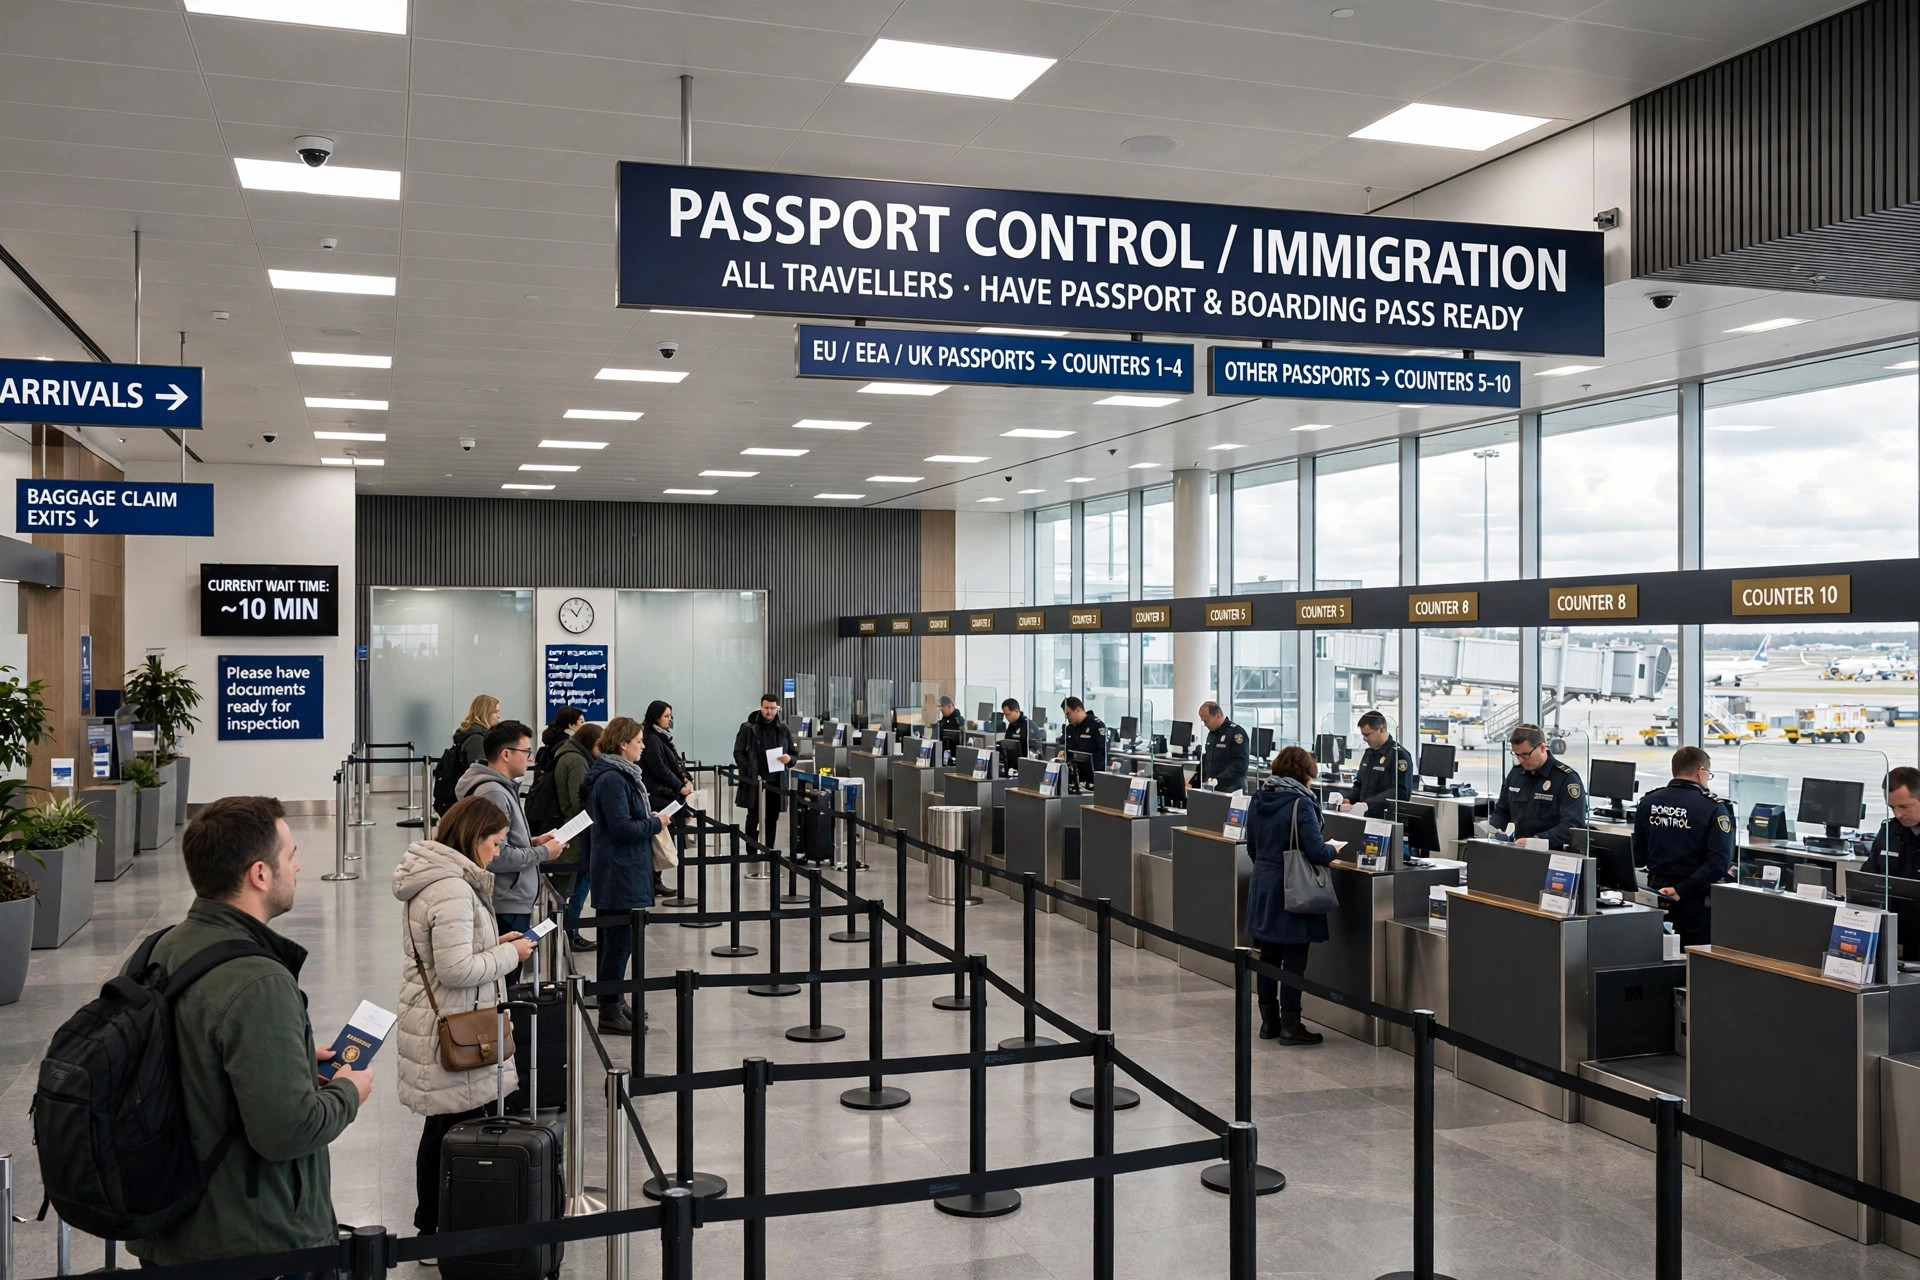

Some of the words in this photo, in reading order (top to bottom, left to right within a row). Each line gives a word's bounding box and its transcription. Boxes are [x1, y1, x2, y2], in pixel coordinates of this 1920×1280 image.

[669, 187, 951, 253] PASSPORT
[966, 208, 1205, 274] CONTROL
[1218, 224, 1237, 273] /
[1252, 227, 1567, 293] IMMIGRATION
[722, 260, 774, 289] ALL
[782, 263, 953, 299] TRAVELLERS
[981, 275, 1051, 305] HAVE
[1062, 280, 1196, 312] PASSPORT
[1204, 289, 1222, 314] &
[1232, 290, 1366, 322] BOARDING
[1376, 299, 1435, 326] PASS
[1446, 302, 1524, 332] READY
[814, 340, 836, 361] EU
[842, 341, 850, 363] /
[857, 342, 890, 363] EEA
[895, 344, 902, 365] /
[909, 345, 933, 365] UK
[939, 347, 1035, 370] PASSPORTS
[1063, 353, 1150, 376] COUNTERS
[1225, 361, 1277, 382] OTHER
[1283, 364, 1370, 387] PASSPORTS
[1395, 369, 1473, 391] COUNTERS
[0, 378, 143, 408] ARRIVALS
[28, 489, 115, 506] BAGGAGE
[122, 491, 176, 507] CLAIM
[28, 510, 76, 526] EXITS
[208, 580, 263, 591] CURRENT
[266, 580, 295, 591] WAIT
[298, 580, 329, 592] TIME:
[1557, 594, 1613, 611] COUNTER
[1618, 593, 1626, 610] 8
[1742, 586, 1814, 606] COUNTER
[1820, 585, 1838, 604] 10
[221, 598, 266, 619] ~10
[274, 598, 318, 619] MIN
[1301, 605, 1337, 619] COUNTER
[1415, 600, 1459, 615] COUNTER
[1462, 599, 1469, 614] 8
[228, 667, 272, 679] Please
[277, 666, 310, 678] have
[227, 683, 305, 696] documents
[228, 699, 267, 716] ready
[271, 699, 291, 712] for
[228, 717, 299, 733] inspection
[1651, 804, 1687, 818] BORDER
[1649, 815, 1692, 829] CONTROL
